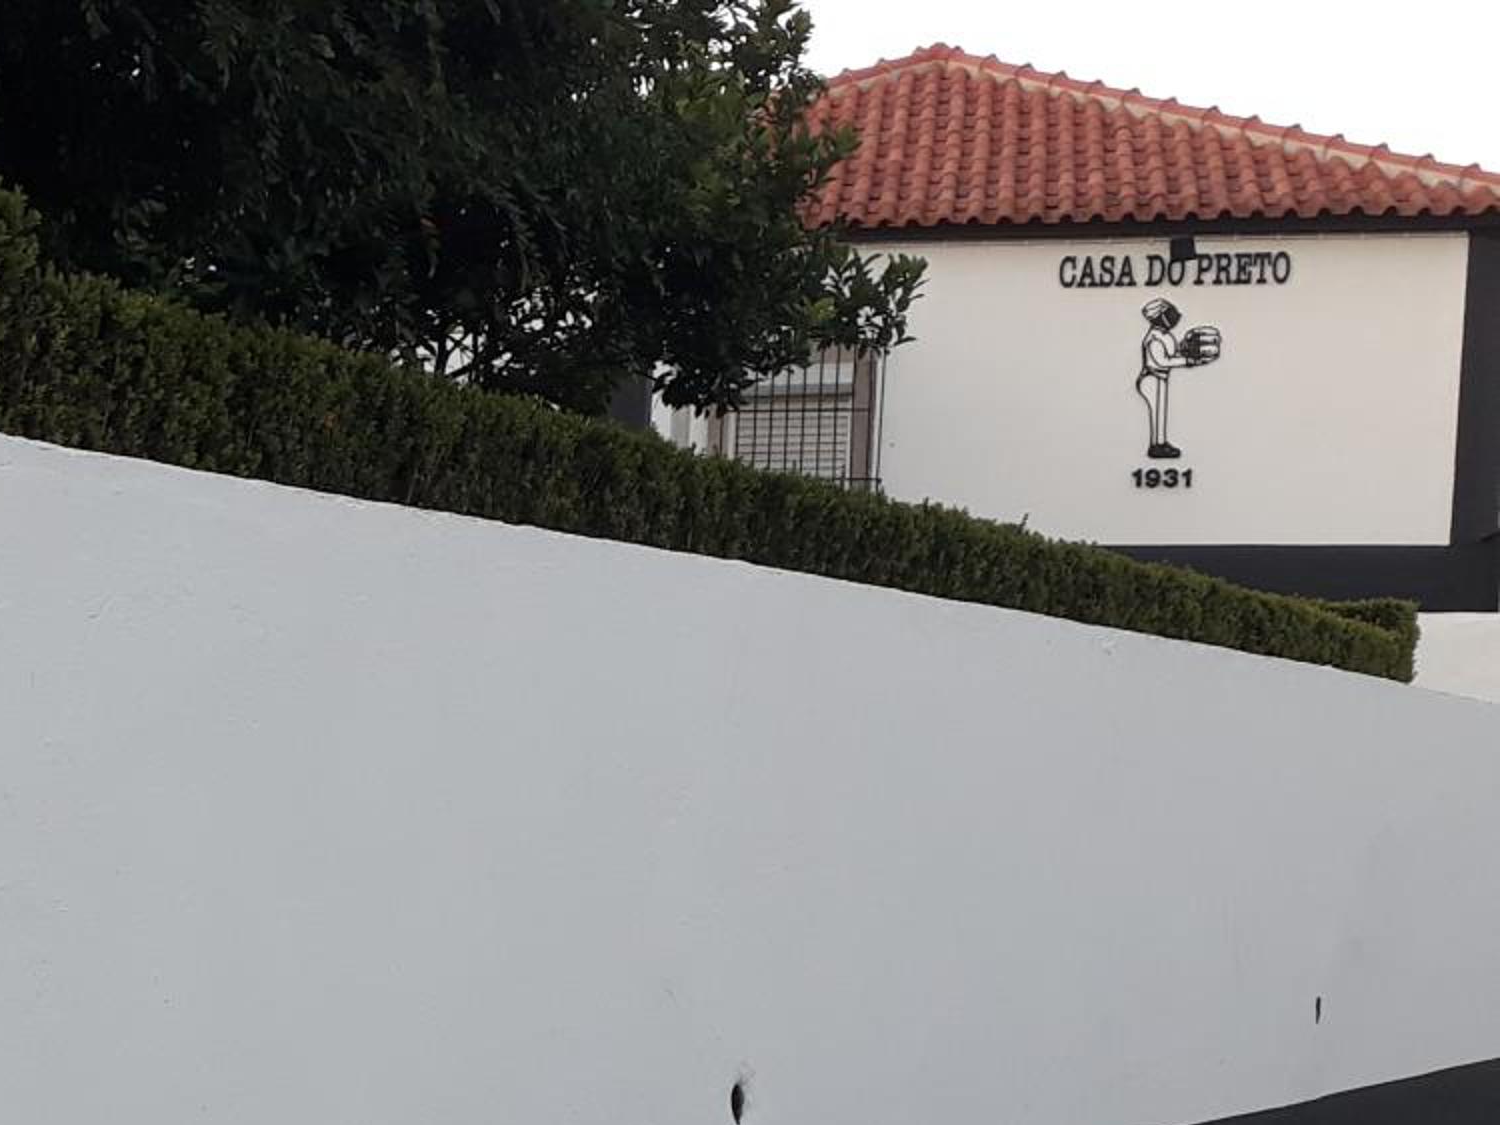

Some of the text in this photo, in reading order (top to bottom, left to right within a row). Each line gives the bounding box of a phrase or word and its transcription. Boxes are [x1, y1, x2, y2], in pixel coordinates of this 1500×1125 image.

[1059, 251, 1291, 288] CASA DO PRETO
[1131, 468, 1193, 489] 1931
